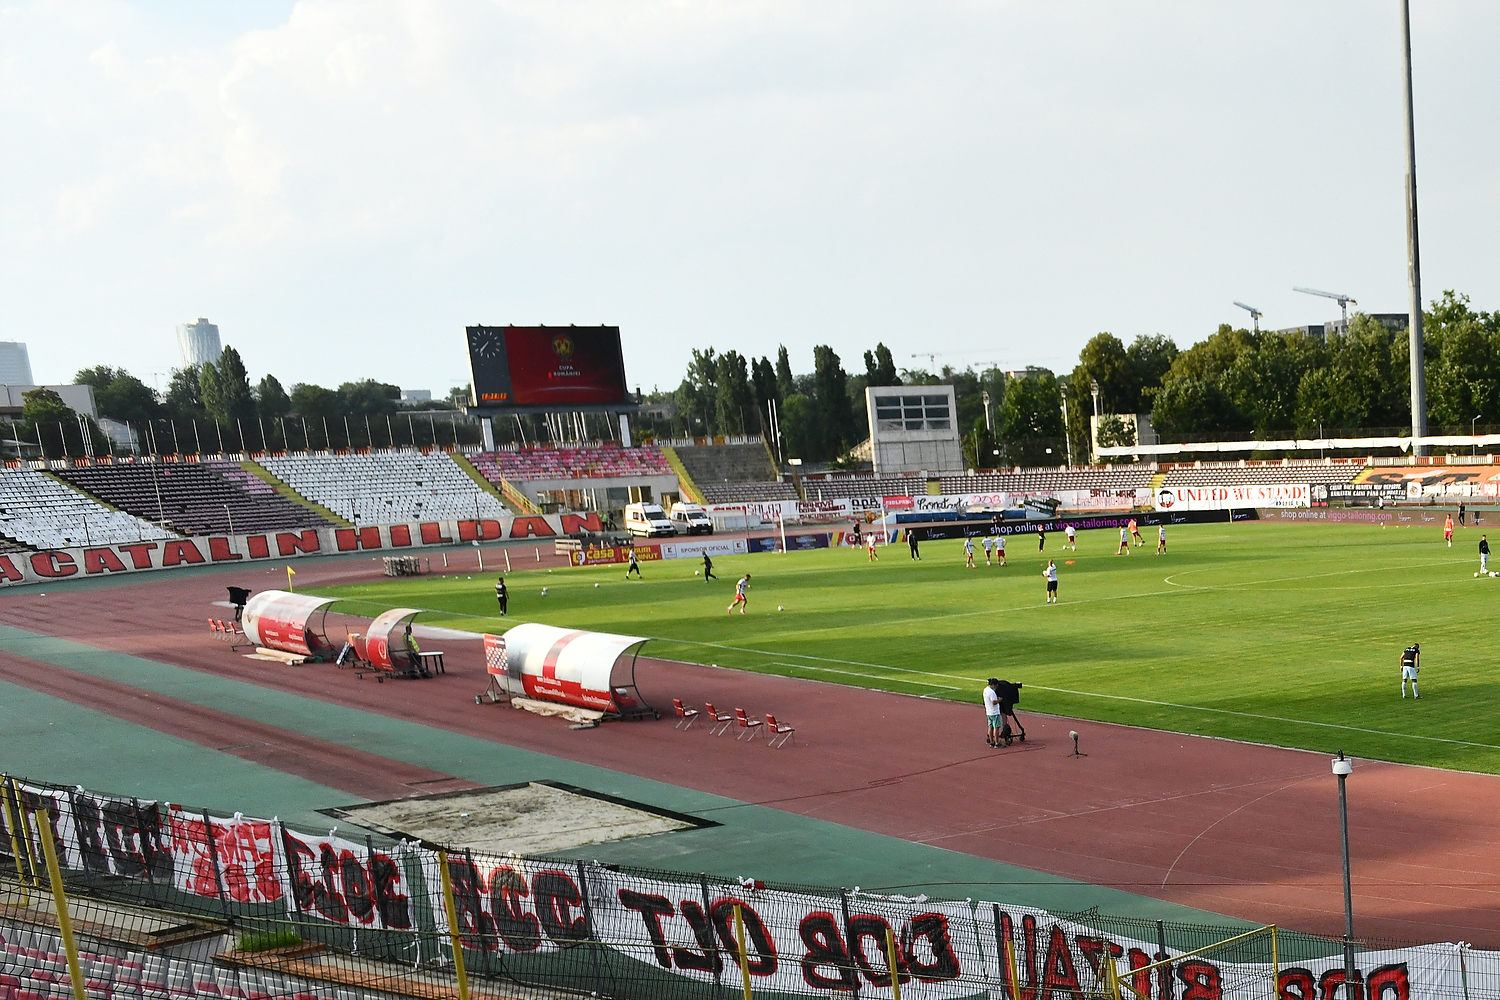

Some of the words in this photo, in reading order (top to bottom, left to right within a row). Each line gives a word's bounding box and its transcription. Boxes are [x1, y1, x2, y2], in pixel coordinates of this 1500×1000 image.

[1177, 488, 1229, 502] UNITED
[1233, 487, 1253, 500] WE
[1280, 509, 1297, 521] shop
[1297, 510, 1319, 519] online
[1319, 511, 1326, 519] at
[1327, 510, 1393, 523] viggo-tailoring.com
[990, 523, 1013, 536] shop
[1044, 522, 1054, 531] at
[30, 530, 320, 578] CATALIN
[334, 512, 604, 551] HILDAN
[680, 546, 708, 554] SPONSOR
[709, 544, 730, 552] OFICIAL
[586, 548, 615, 560] casa
